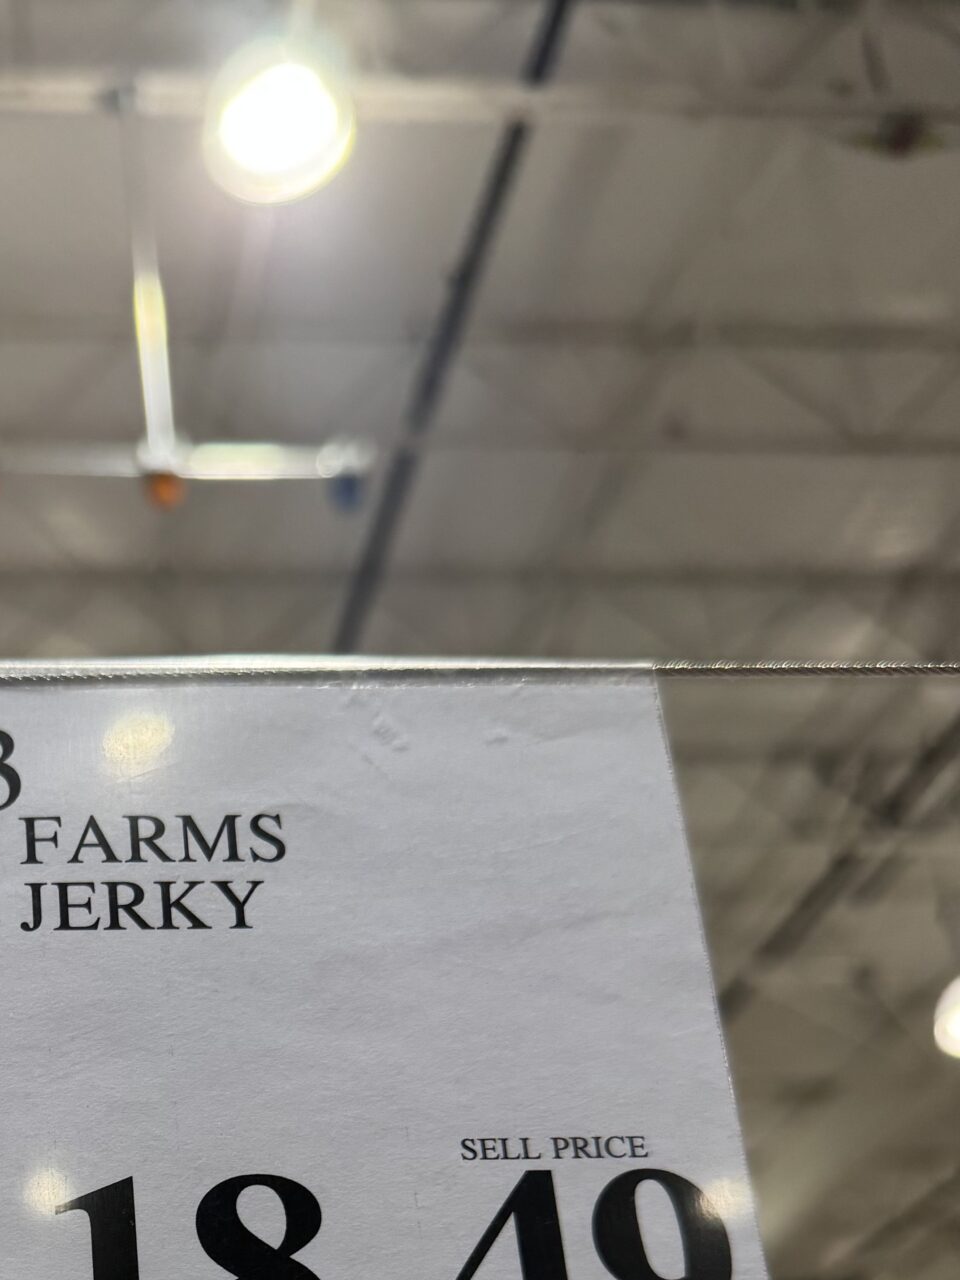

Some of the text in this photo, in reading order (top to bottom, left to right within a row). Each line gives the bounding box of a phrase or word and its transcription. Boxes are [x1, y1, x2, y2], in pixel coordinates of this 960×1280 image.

[18, 813, 287, 865] FARMS
[19, 880, 265, 932] JERKY
[460, 1135, 649, 1161] SELL PRICE
